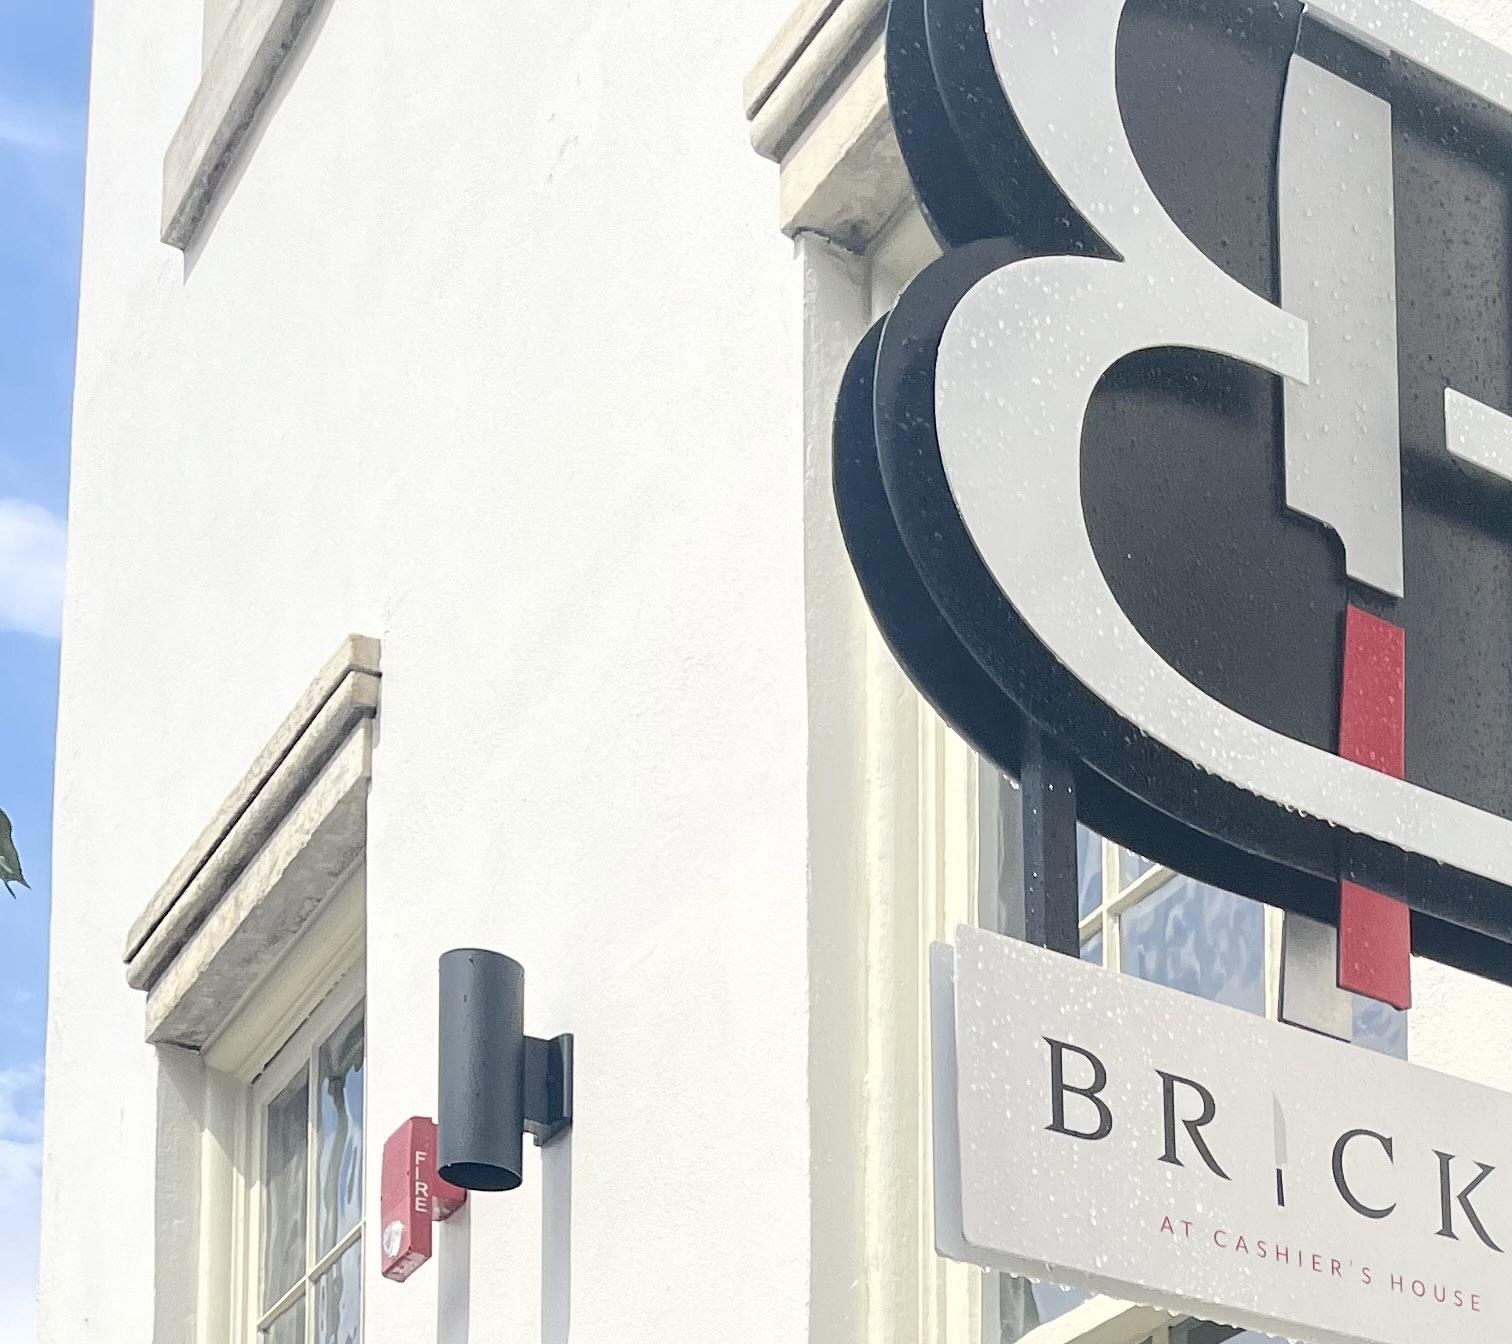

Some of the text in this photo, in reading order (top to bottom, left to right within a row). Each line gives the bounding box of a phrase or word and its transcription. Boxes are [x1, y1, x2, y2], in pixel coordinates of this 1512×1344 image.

[415, 1150, 428, 1213] FIRE
[1160, 1215, 1481, 1312] AT CASHIER'S HOUSE
